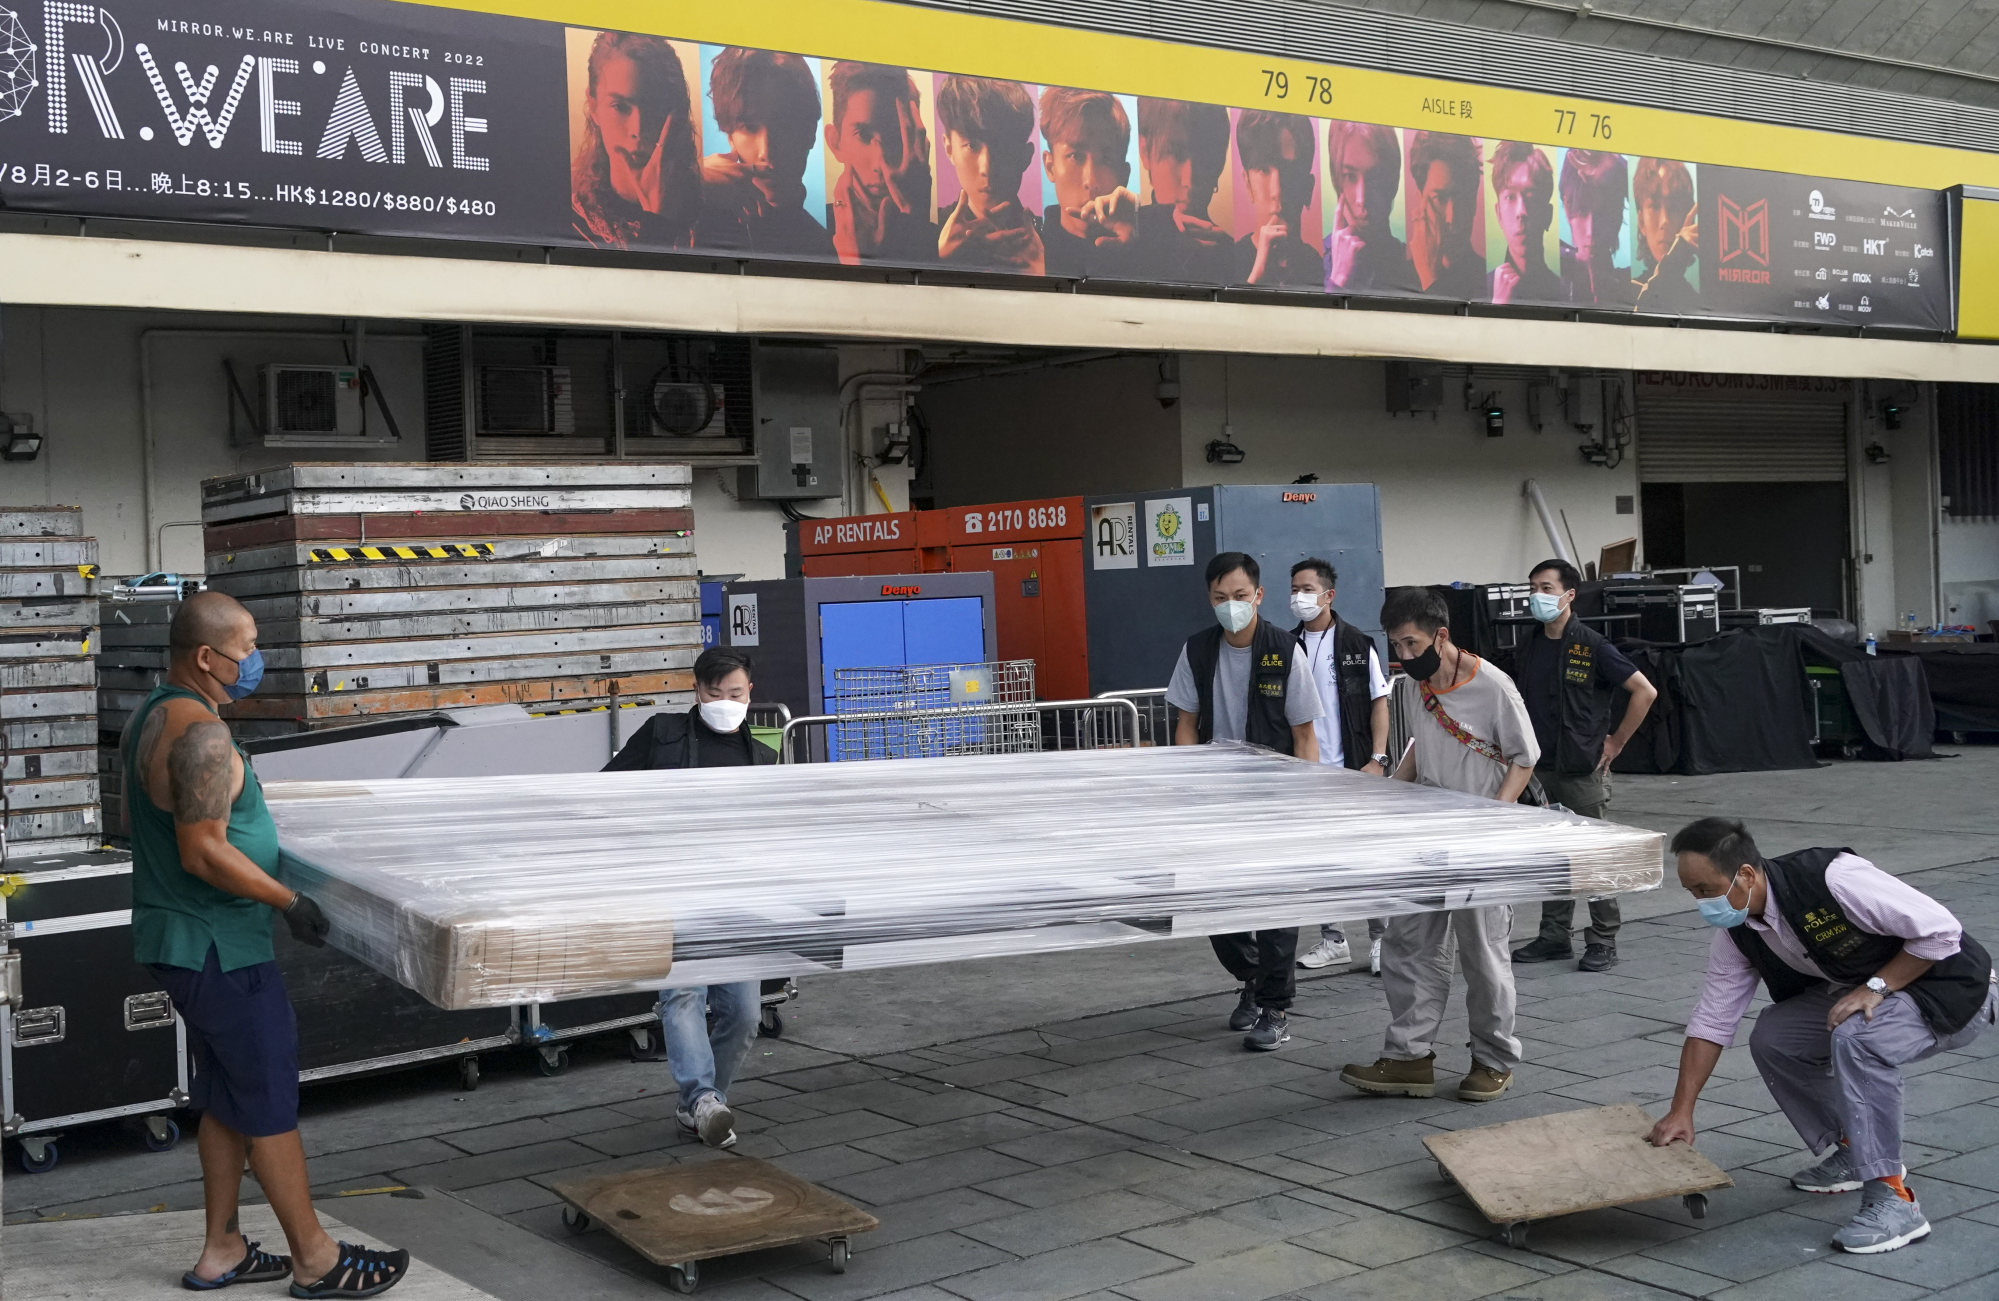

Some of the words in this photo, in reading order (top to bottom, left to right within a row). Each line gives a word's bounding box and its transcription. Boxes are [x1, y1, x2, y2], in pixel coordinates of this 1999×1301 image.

[157, 19, 294, 45] MIRROR.WE.ARE
[308, 36, 345, 51] LIVE
[360, 41, 430, 61] CONCERT
[444, 52, 485, 67] 2022
[1261, 69, 1289, 99] 79
[1305, 76, 1333, 105] 78
[1422, 97, 1456, 116] AISLE
[1460, 101, 1473, 120] 段
[1554, 109, 1577, 135] 77
[1590, 113, 1613, 140] 76
[1814, 231, 1837, 246] FWD
[1863, 238, 1886, 256] HKT
[478, 496, 509, 509] QIAO
[510, 496, 549, 507] SHENG
[1283, 492, 1317, 504] Denyo
[988, 509, 1023, 532] 2170
[1028, 505, 1067, 529] 8638
[814, 526, 833, 545] AP
[836, 519, 900, 543] RENTALS
[1127, 515, 1135, 555] RENTALS
[881, 585, 922, 597] Denyo
[1803, 913, 1838, 933] POLICE
[1815, 929, 1835, 942] CRM
[1834, 924, 1847, 934] KW
